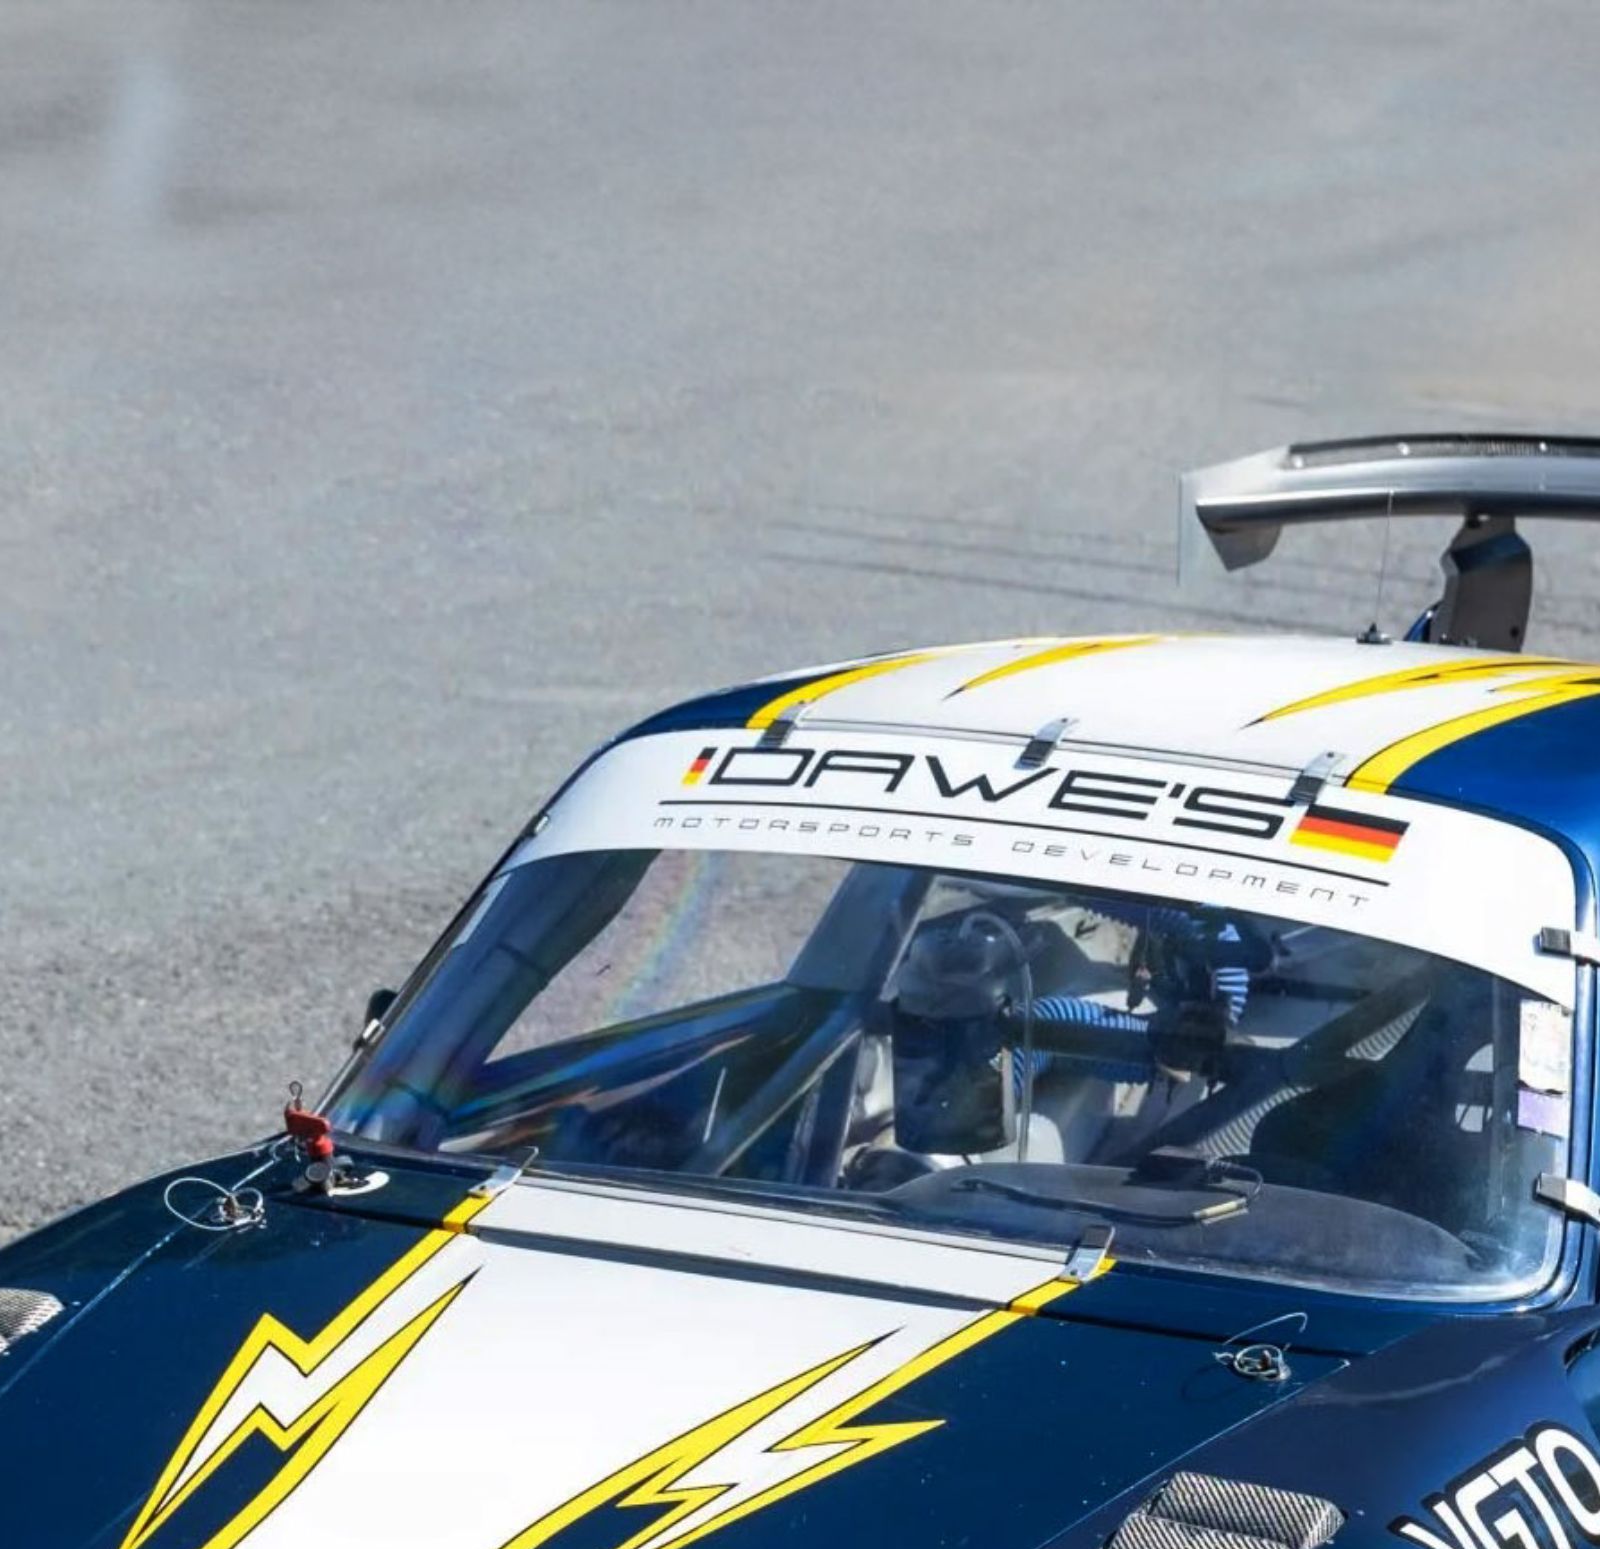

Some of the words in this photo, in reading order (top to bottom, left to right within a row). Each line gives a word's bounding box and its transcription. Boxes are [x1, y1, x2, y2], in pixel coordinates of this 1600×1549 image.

[707, 747, 1294, 841] DAWE'S
[653, 816, 977, 848] MOTORSPORTS
[1010, 840, 1371, 908] DEVELOPMENT
